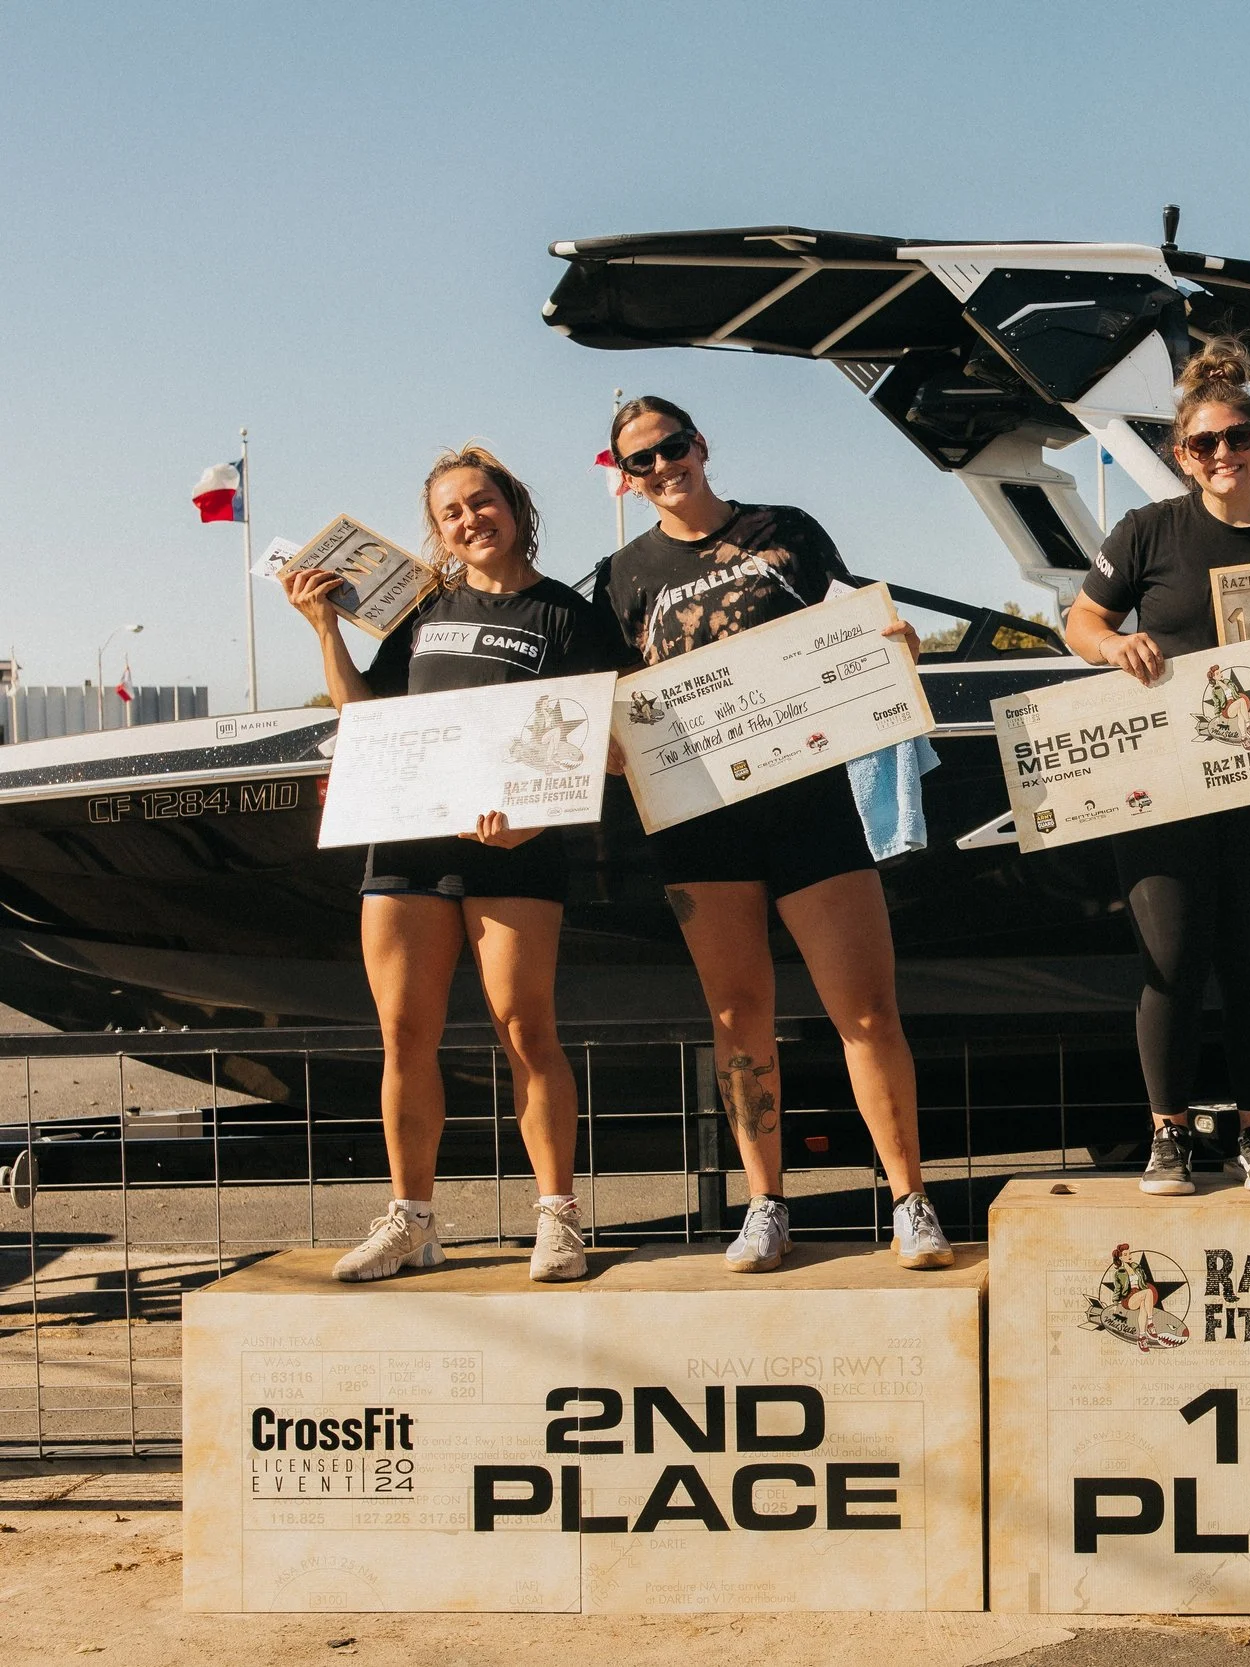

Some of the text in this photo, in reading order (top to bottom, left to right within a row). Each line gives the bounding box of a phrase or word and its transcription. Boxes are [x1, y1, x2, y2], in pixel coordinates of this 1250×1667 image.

[298, 552, 321, 572] AZ'N
[317, 523, 354, 556] HEALTH
[365, 566, 422, 621] RX WOMEN
[425, 632, 539, 658] UNITY GAMES
[814, 624, 863, 650] 09/14/2024
[782, 651, 803, 661] DATE
[661, 667, 731, 701] RAZ'N HEALTH
[821, 670, 838, 684] $
[665, 678, 734, 710] FITNESS FESTIVAL
[714, 701, 736, 720] with
[738, 695, 749, 712] 3
[749, 689, 766, 706] C's
[872, 702, 909, 722] CrossFit
[1005, 703, 1039, 719] CrossFit
[219, 720, 279, 735] gm MARINE
[656, 700, 809, 767] Two Hundred and Fifty Dollars
[1014, 711, 1169, 759] SHE MADE
[1017, 734, 1142, 776] ME DO IT
[1202, 753, 1246, 777] RAZ'N
[503, 775, 590, 797] RAZ'N HEALTH
[1022, 767, 1092, 789] RX WOMEN
[1205, 771, 1248, 789] FITNESS
[88, 782, 299, 824] CF 1284 MD
[502, 789, 589, 807] FITNESS FESTIVAL
[1065, 806, 1120, 823] CENTURION
[442, 1357, 476, 1369] 5425
[687, 1355, 924, 1382] RNAV (GPS) RWY 13
[834, 1381, 924, 1397] EXEC (EDC)
[252, 1407, 414, 1451] CrossFit
[546, 1385, 825, 1455] 2ND
[252, 1458, 414, 1474] LICENSED 20
[252, 1476, 414, 1492] EVENT 24
[473, 1463, 901, 1532] PLACE
[271, 1513, 325, 1524] 118.825
[650, 1539, 687, 1550] DARTE
